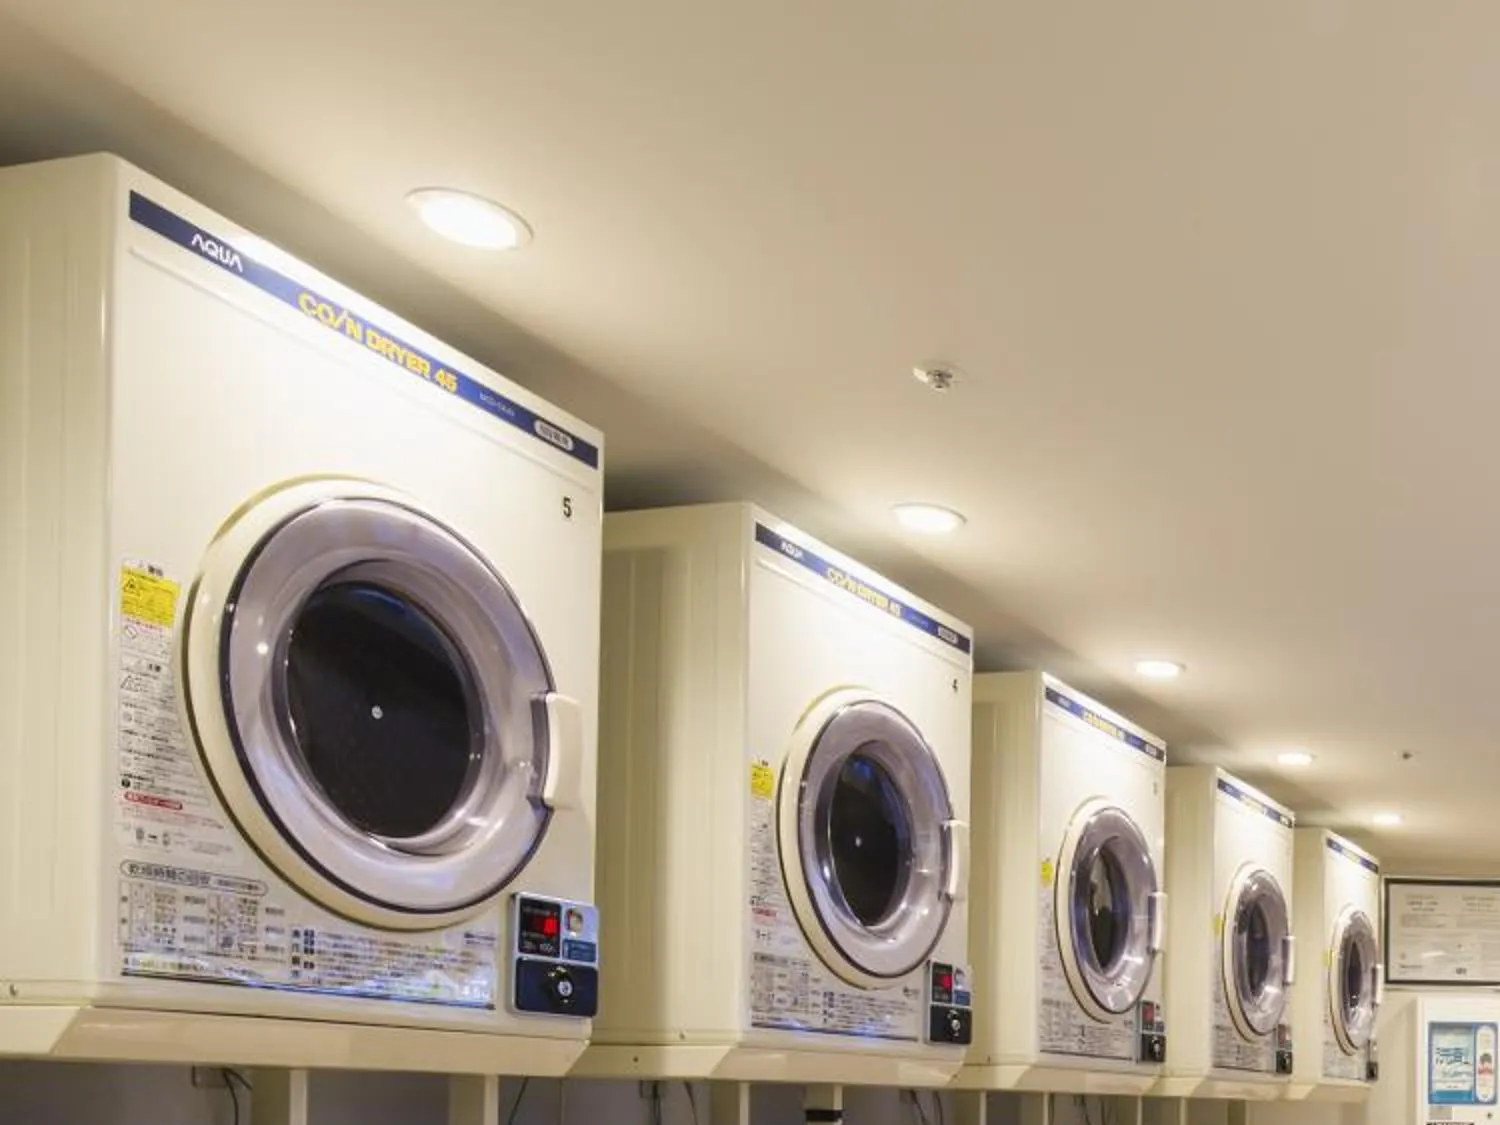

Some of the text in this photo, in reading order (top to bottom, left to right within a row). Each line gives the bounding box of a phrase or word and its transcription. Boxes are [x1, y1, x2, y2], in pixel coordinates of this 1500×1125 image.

[191, 233, 243, 272] AQUA
[366, 328, 431, 378] DRYER
[434, 368, 458, 395] 45
[563, 497, 573, 518] 5
